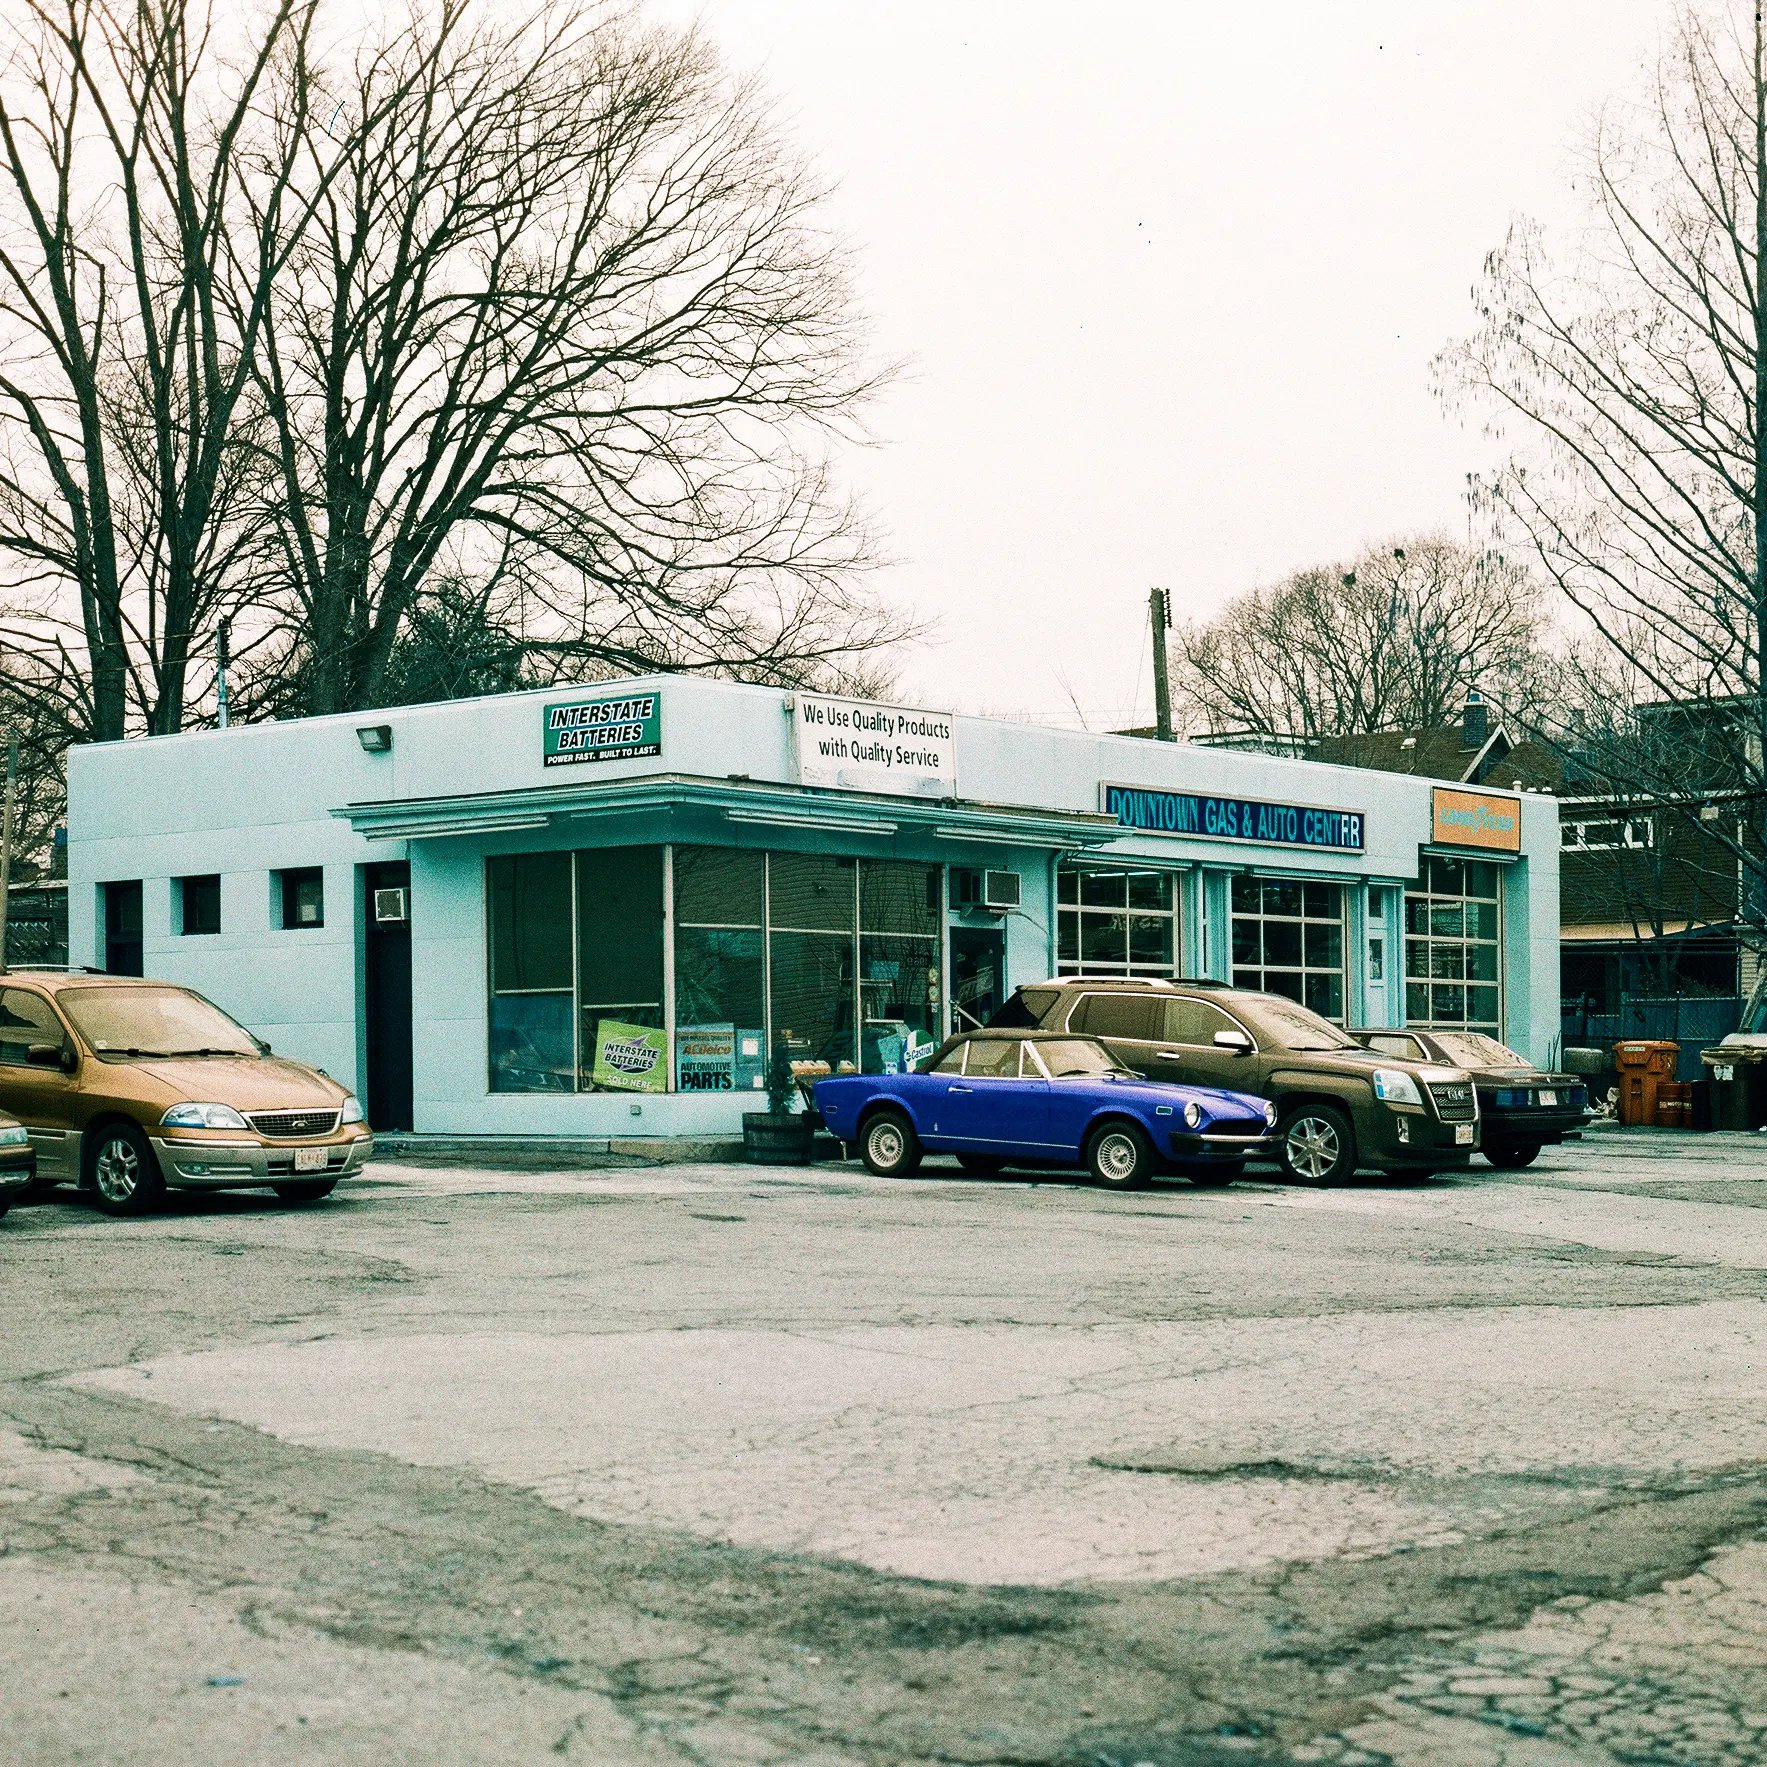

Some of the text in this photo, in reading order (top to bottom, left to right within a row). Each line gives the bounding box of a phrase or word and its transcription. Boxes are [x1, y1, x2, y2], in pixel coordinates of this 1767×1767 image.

[550, 697, 654, 729] INTERSTATE
[803, 703, 950, 739] We Use Quality Products
[558, 723, 643, 750] BATTERIES
[547, 746, 656, 764] POWER FAST. BUILT TO LAST.
[818, 737, 939, 767] with Quality Service
[1111, 789, 1199, 832] DOWNTOWN
[1205, 799, 1237, 836] GAS
[1242, 804, 1252, 837] &
[1258, 805, 1297, 841] AUTO
[604, 1042, 658, 1059] INTERSTATE
[911, 1044, 932, 1060] Castrol
[604, 1053, 654, 1069] BATTERIES
[681, 1062, 732, 1072] AUTOMOTIVE
[607, 1075, 652, 1089] SOLD HERE
[681, 1071, 732, 1089] PARTS
